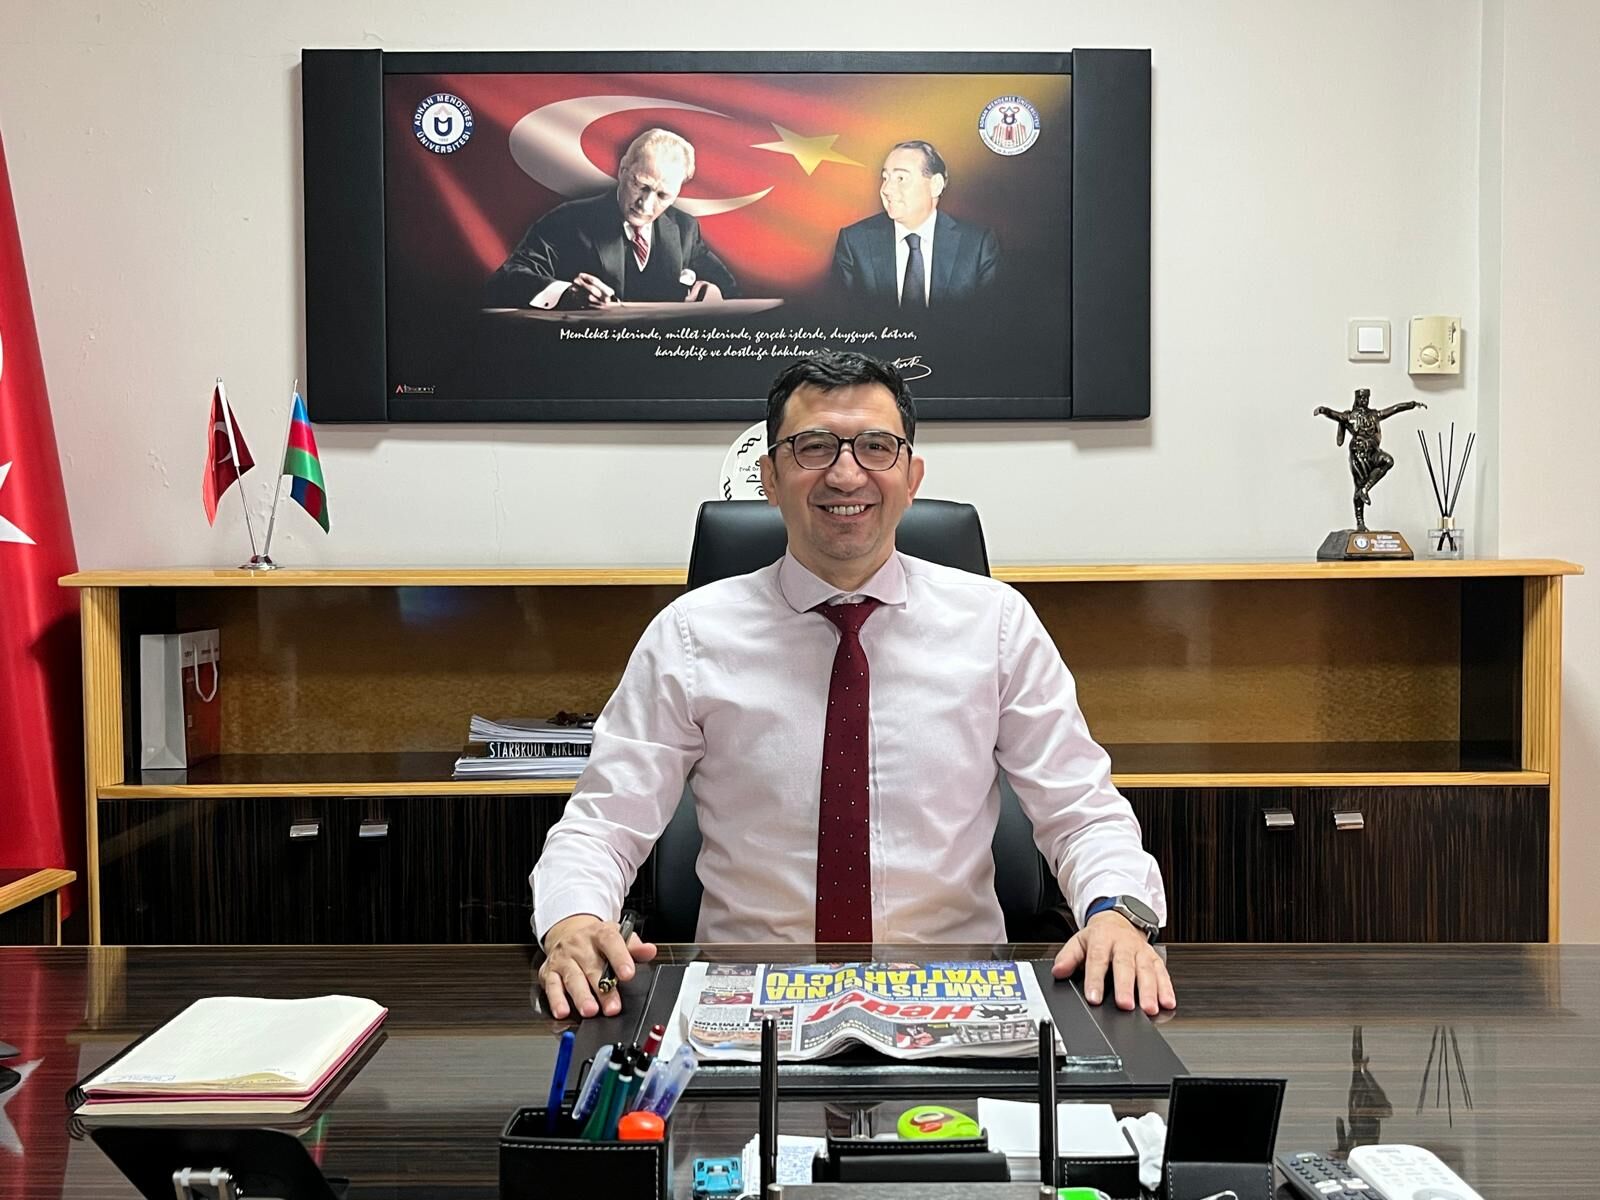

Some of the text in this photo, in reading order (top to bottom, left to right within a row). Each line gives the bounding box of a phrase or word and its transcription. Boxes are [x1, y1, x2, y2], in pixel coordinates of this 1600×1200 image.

[414, 95, 473, 127] ADNAN MENDERES
[560, 328, 610, 340] Memleket
[611, 328, 662, 342] işlerinde,
[665, 328, 700, 340] millet
[701, 328, 752, 342] işlerinde,
[754, 328, 787, 344] gerçek
[788, 328, 827, 342] işlerde,
[830, 328, 878, 344] duyguya,
[655, 345, 818, 361] kardeşliğe ve dostluğa bakılma
[489, 742, 592, 758] STARBROOK AIRLINE
